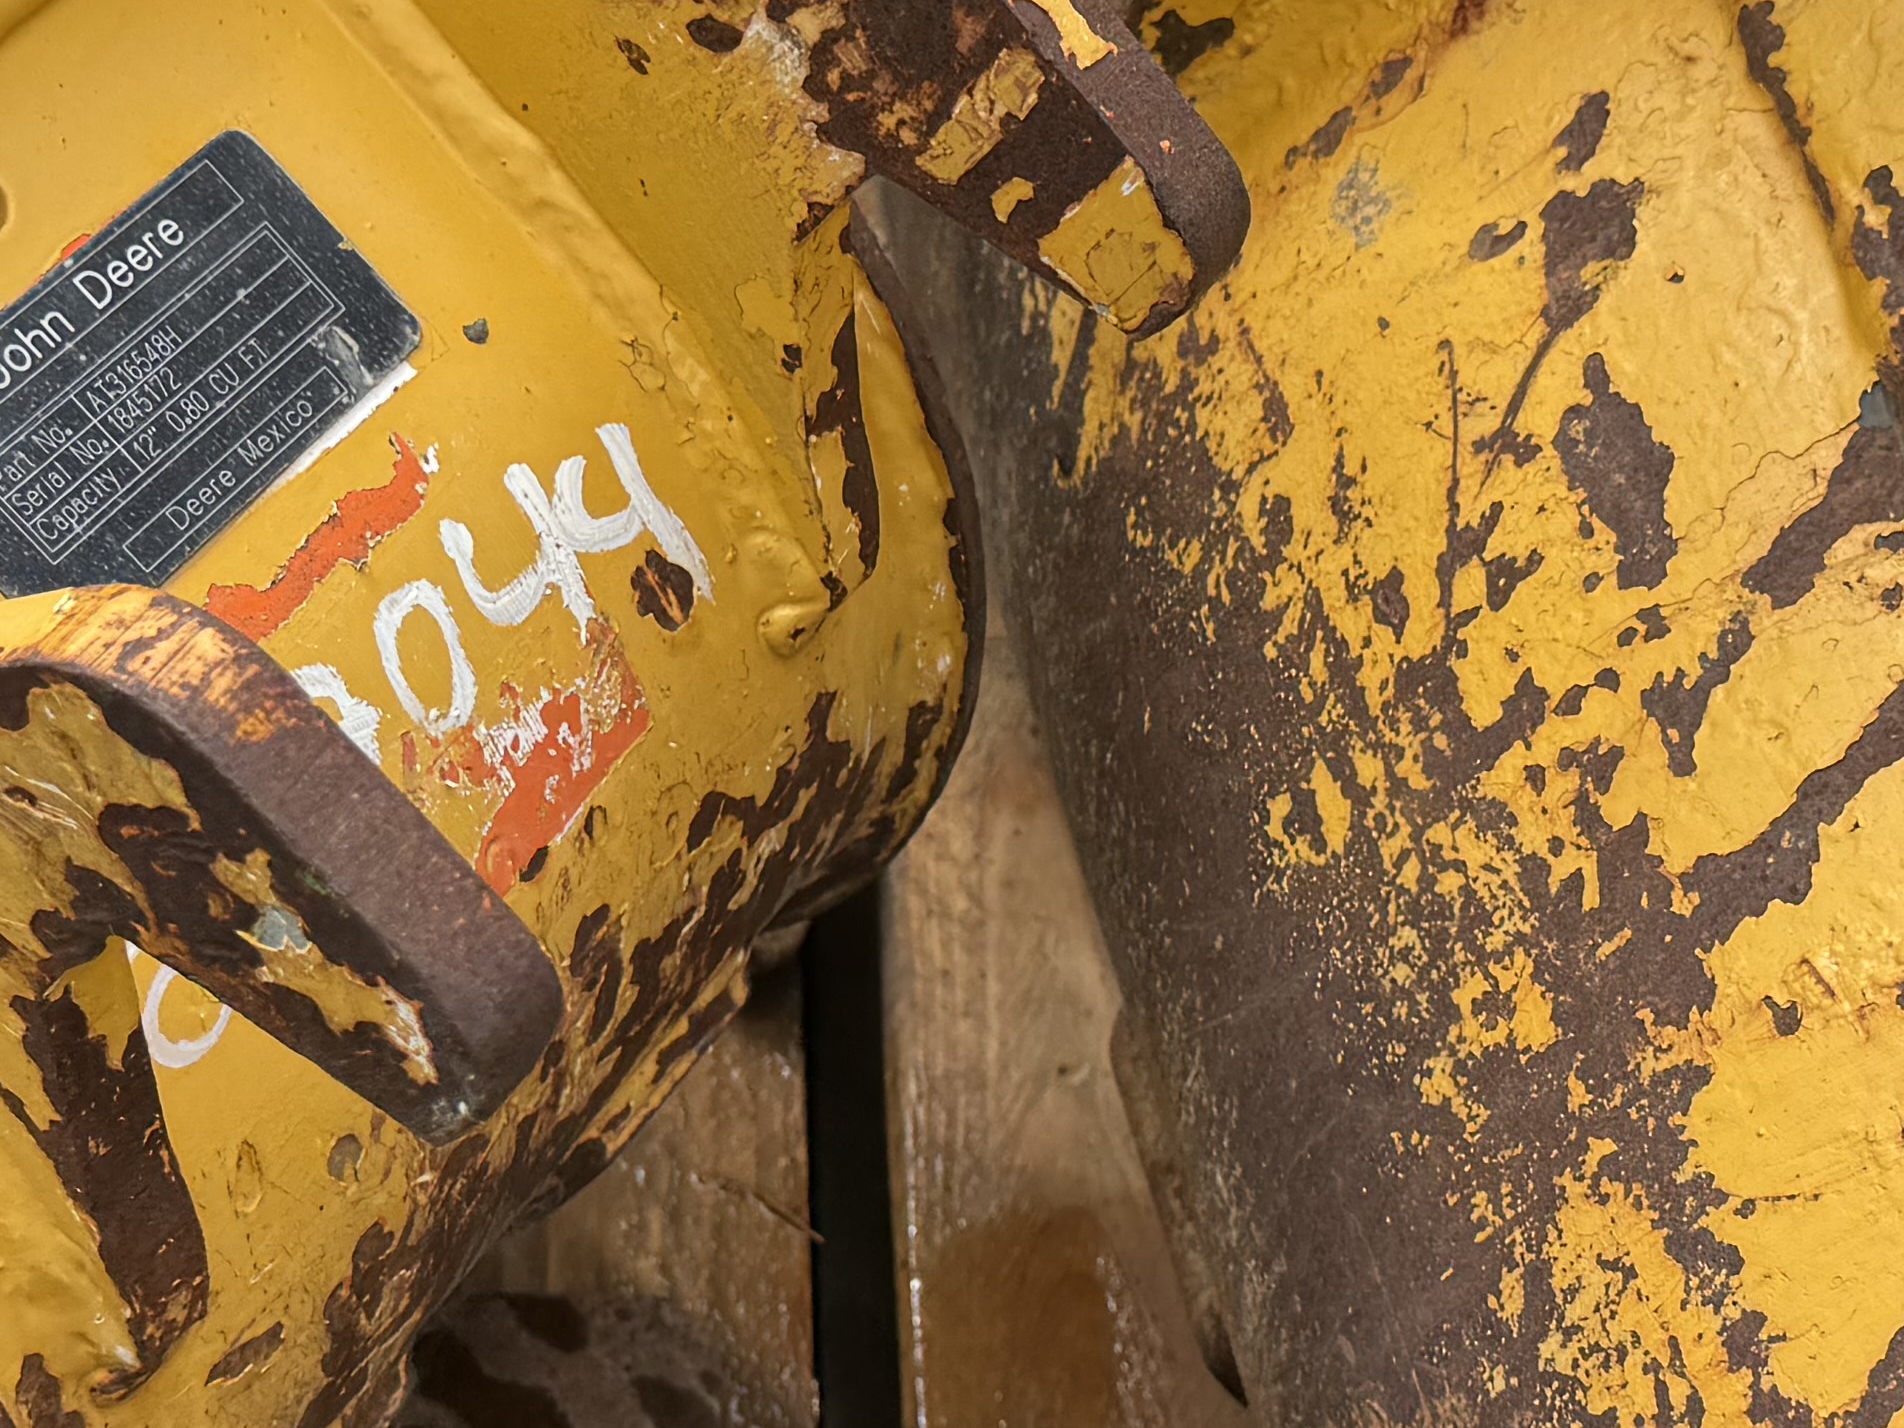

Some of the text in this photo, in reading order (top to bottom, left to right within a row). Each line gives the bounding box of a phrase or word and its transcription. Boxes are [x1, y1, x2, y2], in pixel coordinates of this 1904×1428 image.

[73, 217, 184, 309] Deere
[13, 368, 182, 516] Serial No. 1845172
[33, 420, 73, 454] No.
[87, 325, 184, 412] AT316548H
[37, 471, 123, 540] Capacity
[133, 426, 158, 461] 12"
[165, 395, 209, 433] 0.80
[210, 361, 239, 396] CU
[166, 399, 313, 531] Deere Mexico
